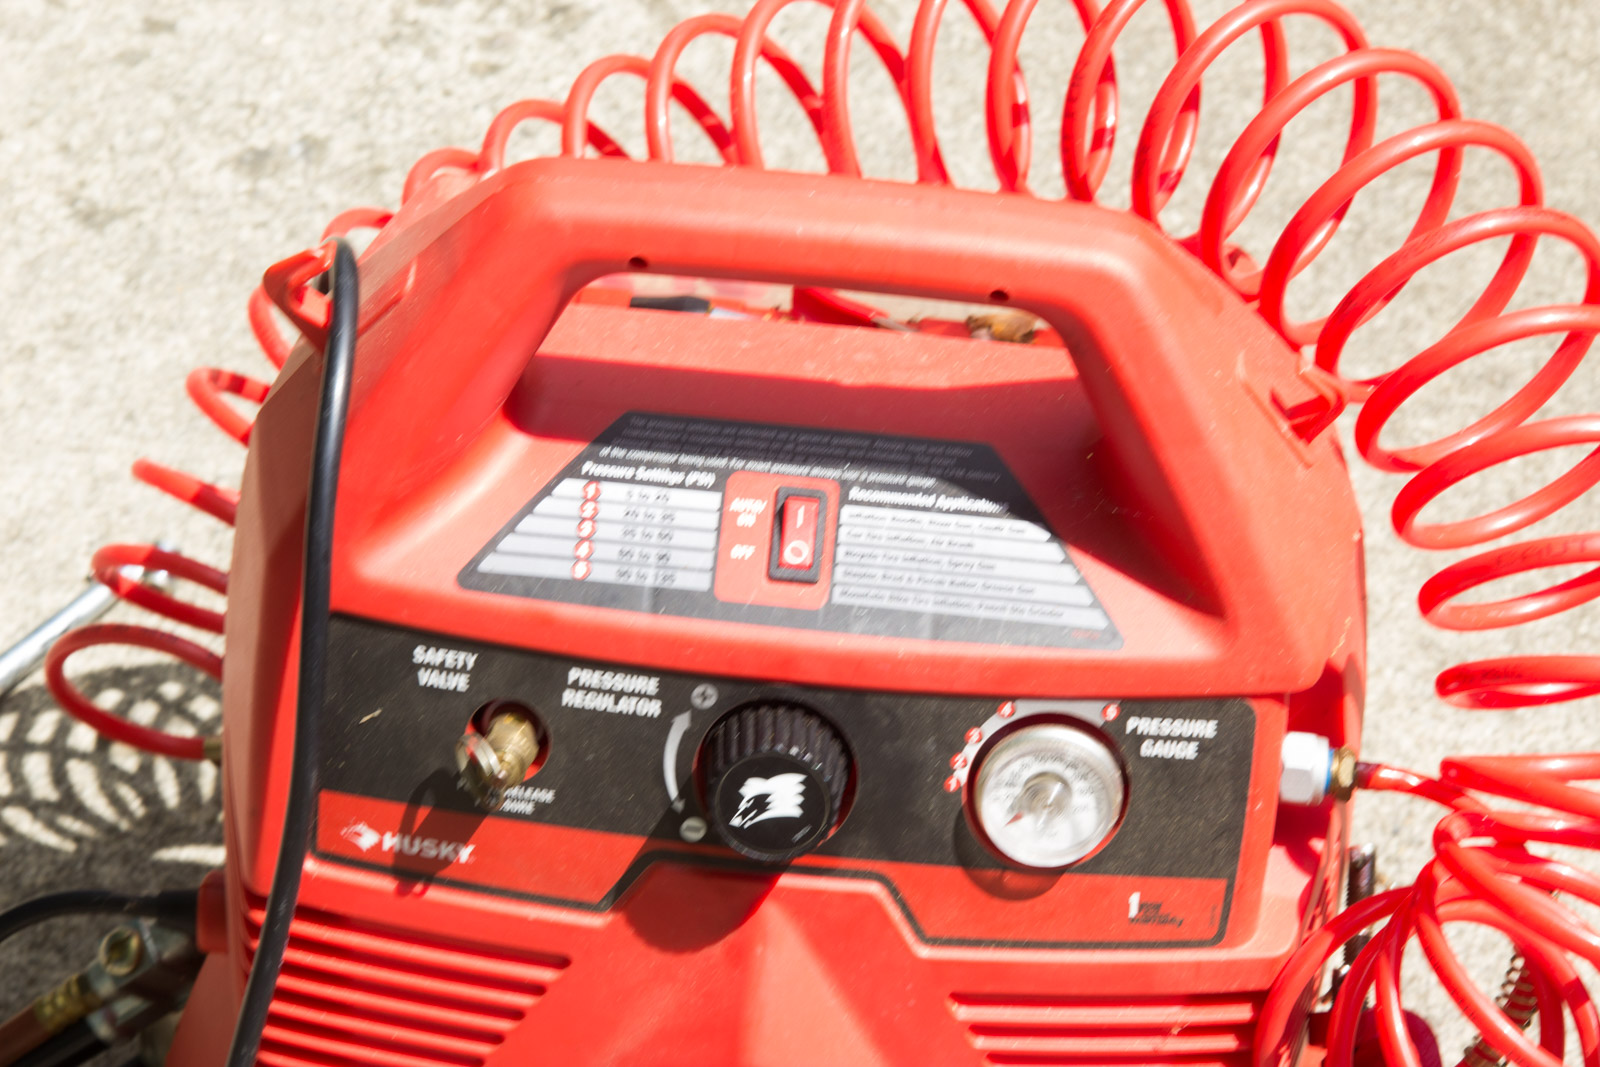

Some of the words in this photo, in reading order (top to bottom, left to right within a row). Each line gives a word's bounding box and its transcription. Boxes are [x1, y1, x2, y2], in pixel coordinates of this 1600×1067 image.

[581, 460, 637, 481] Pressure
[634, 465, 686, 487] Settings
[848, 485, 937, 508] Recommended
[412, 644, 478, 672] SAFETY
[417, 667, 471, 693] VALVE
[566, 666, 661, 697] PRESSURE
[561, 687, 663, 719] REGULATOR
[1125, 715, 1219, 739] PRESSURE
[1140, 738, 1200, 760] GAUGE
[381, 831, 476, 864] HUSKY
[1128, 891, 1141, 919] 1
